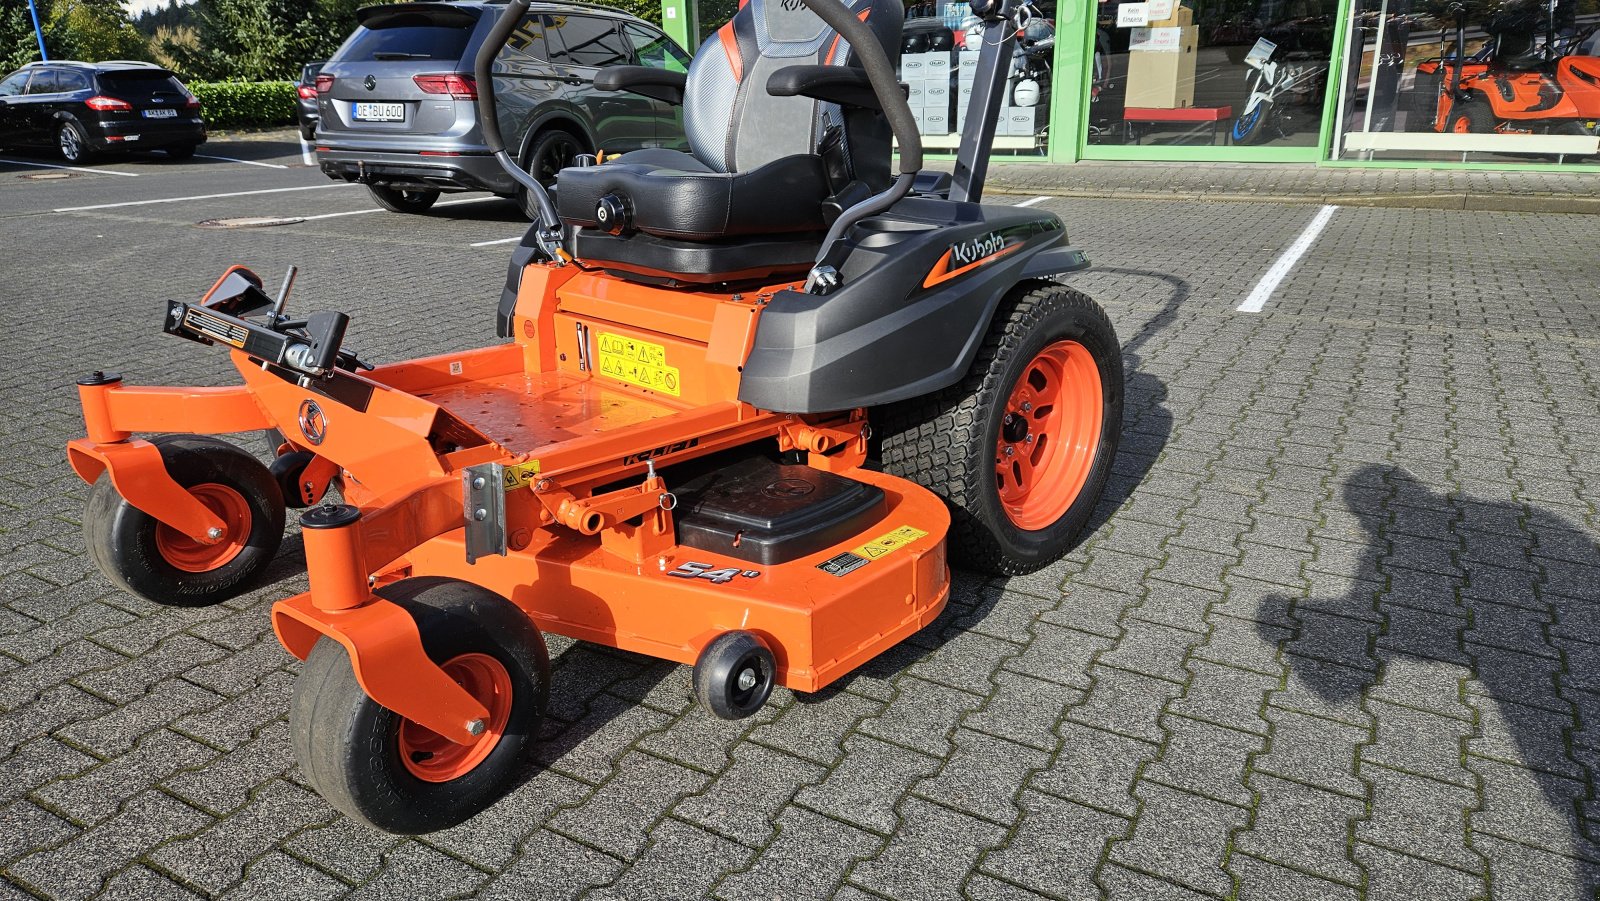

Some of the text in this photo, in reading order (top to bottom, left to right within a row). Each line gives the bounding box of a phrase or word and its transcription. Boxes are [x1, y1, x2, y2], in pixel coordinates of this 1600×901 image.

[357, 105, 402, 117] OE BU 600
[954, 232, 1005, 263] Kubota
[626, 439, 697, 466] K-LIFT
